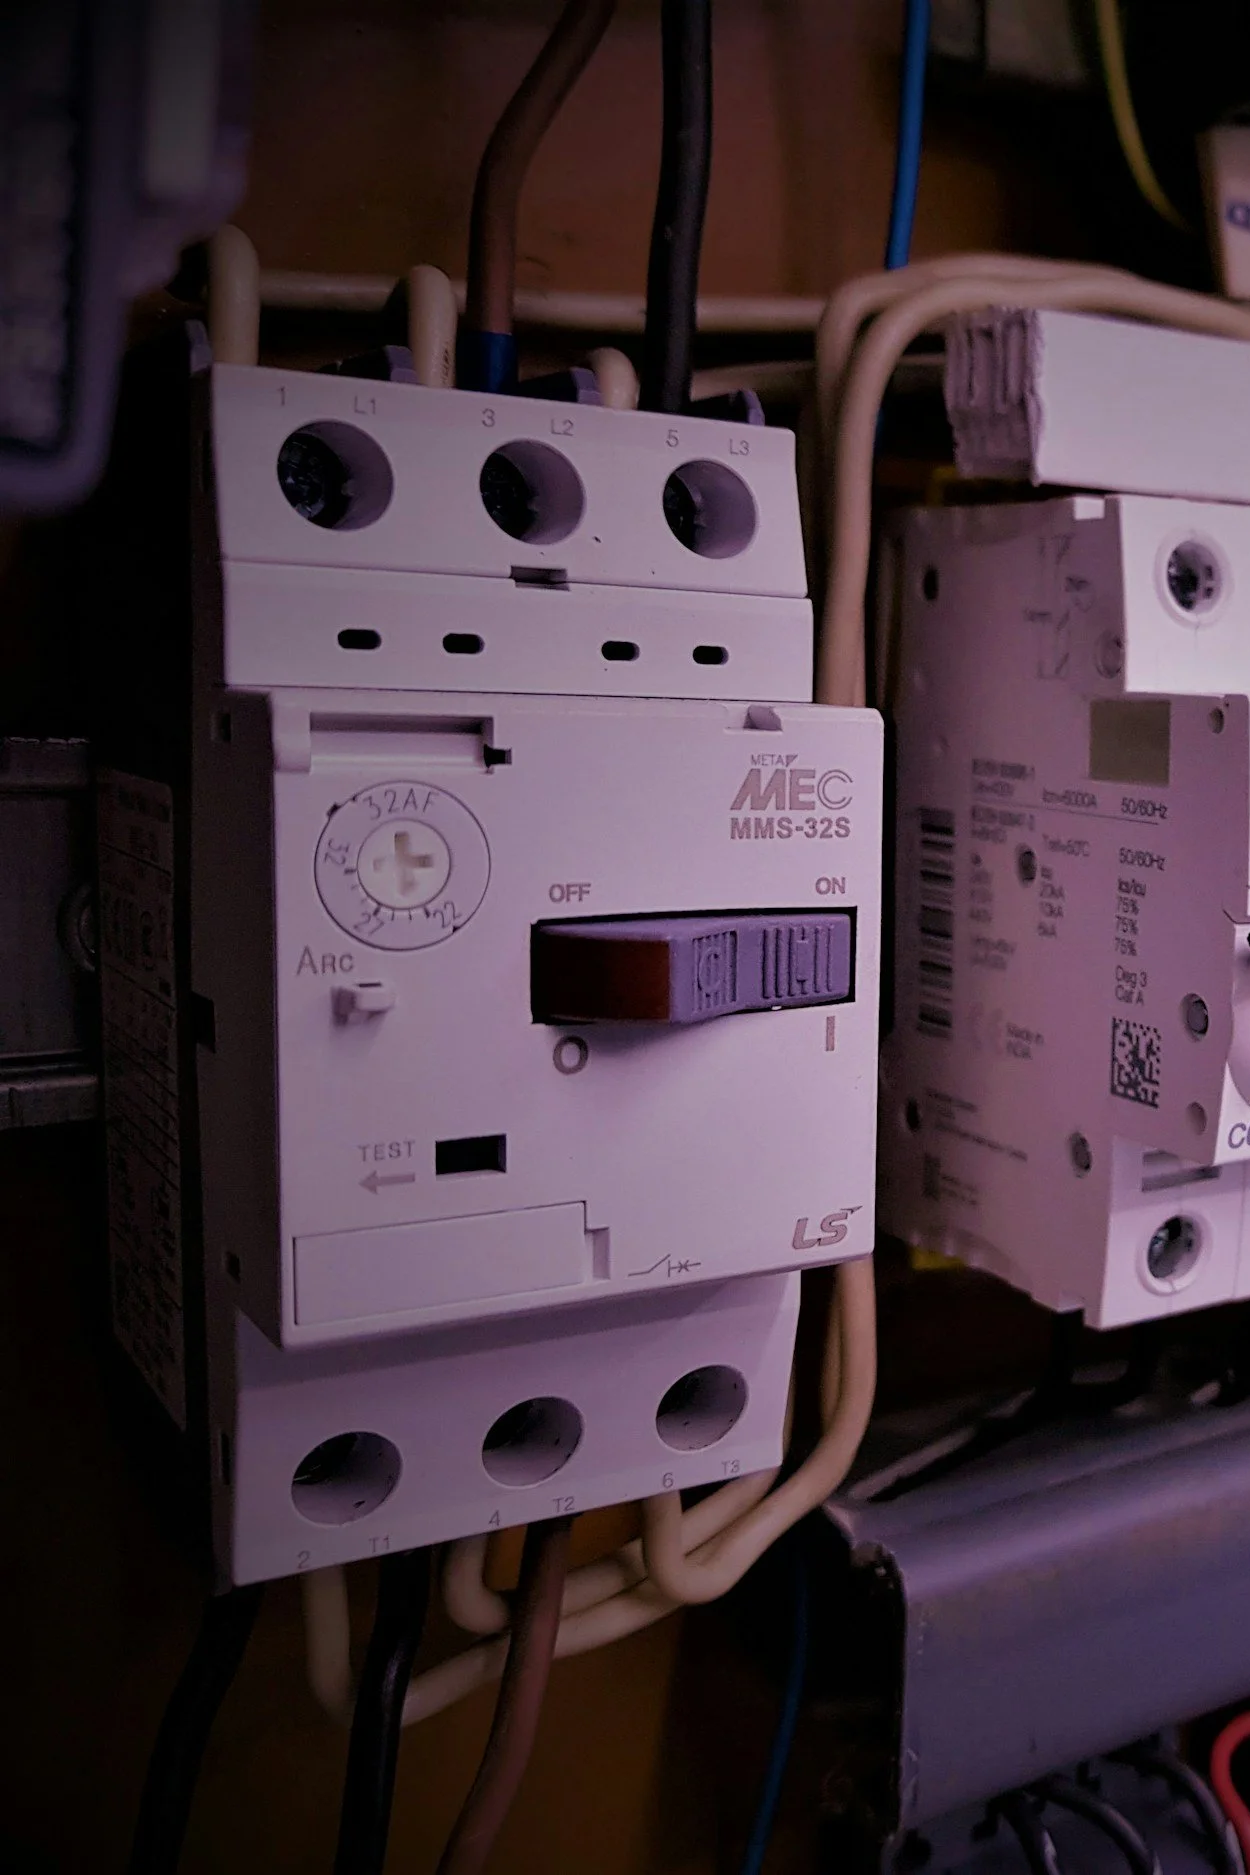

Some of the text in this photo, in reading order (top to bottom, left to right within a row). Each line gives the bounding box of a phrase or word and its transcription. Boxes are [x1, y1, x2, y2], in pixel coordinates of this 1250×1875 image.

[354, 396, 376, 414] L1
[482, 409, 495, 427] 3
[551, 419, 574, 436] L2
[666, 429, 679, 447] 5
[729, 439, 750, 455] L3
[751, 754, 788, 767] META
[729, 768, 854, 811] MEC
[363, 788, 439, 820] 32AF
[1121, 797, 1168, 819] 50/60Hz
[730, 817, 850, 839] MMS-32S
[549, 883, 591, 902] OFF
[815, 877, 846, 895] ON
[358, 1140, 416, 1163] TEST
[792, 1210, 850, 1251] LS
[721, 1460, 740, 1475] T3
[662, 1471, 674, 1489] 6
[553, 1496, 575, 1513] T2
[489, 1509, 501, 1527] 4
[368, 1535, 390, 1553] T1
[297, 1550, 310, 1570] 2
